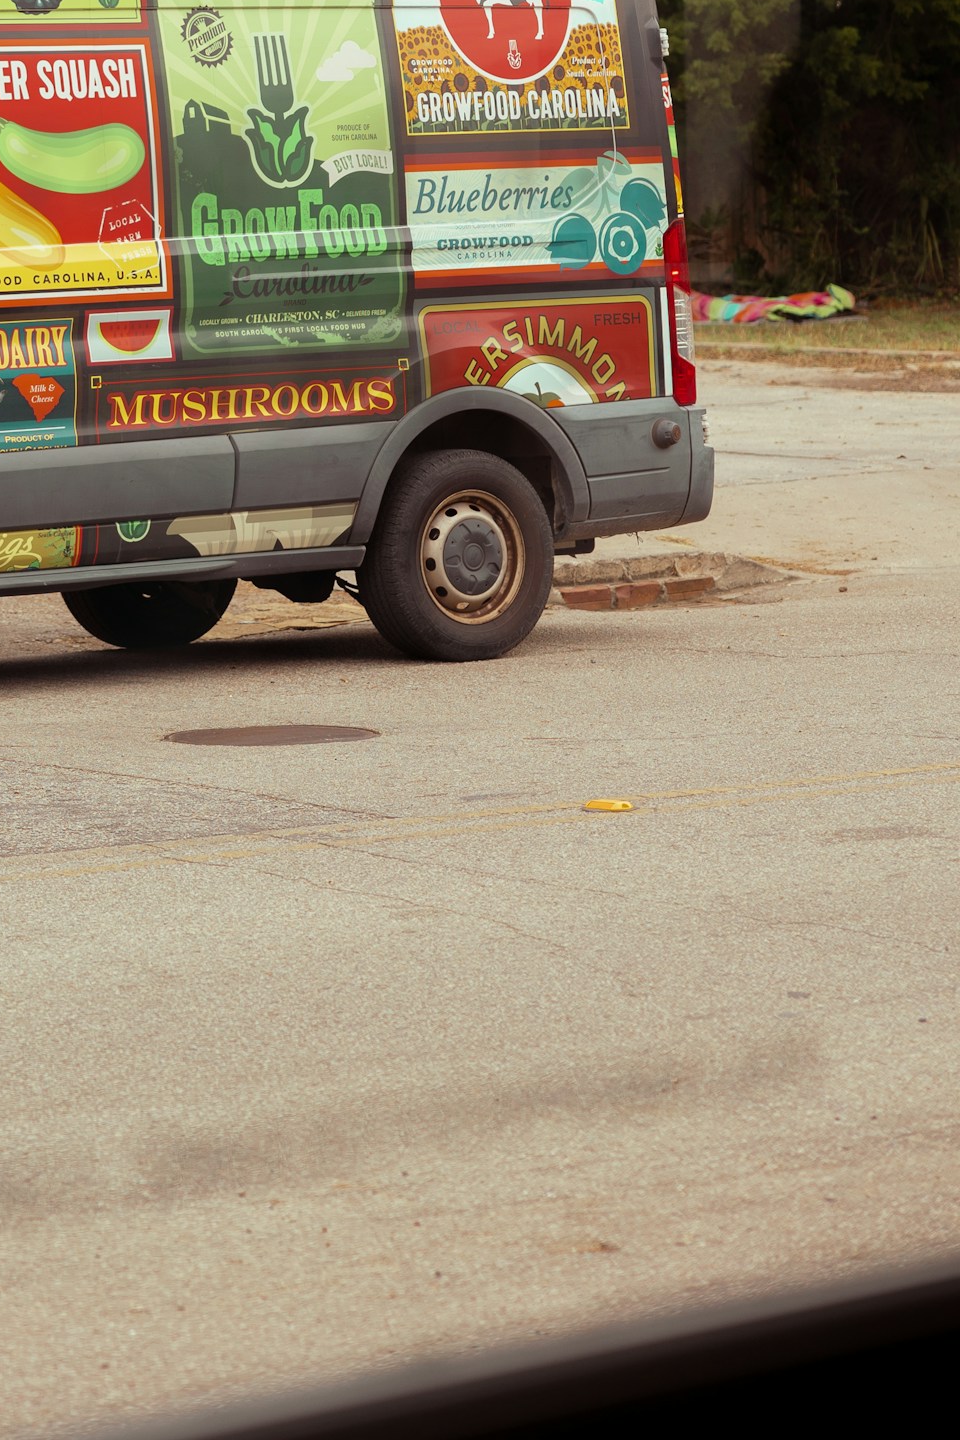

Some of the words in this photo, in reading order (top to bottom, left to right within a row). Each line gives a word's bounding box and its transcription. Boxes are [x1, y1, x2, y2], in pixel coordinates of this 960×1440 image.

[188, 21, 227, 52] Premium
[571, 56, 596, 65] Product
[36, 58, 137, 101] SQUASH
[566, 69, 585, 78] South
[416, 90, 521, 123] GROWFOOD
[527, 88, 620, 119] CAROLINA
[336, 123, 362, 131] PRODUCE
[363, 123, 370, 131] OF
[331, 134, 350, 142] SOUTH
[350, 133, 378, 141] CAROLINA
[333, 154, 355, 174] BUY
[356, 153, 388, 169] LOCAL!
[412, 173, 574, 215] Blueberries
[108, 213, 141, 231] LOCAL
[437, 235, 534, 251] GROWFOOD
[457, 251, 512, 260] CAROLINA
[33, 271, 111, 285] CAROLINA,
[116, 269, 158, 280] U.S.A.
[231, 262, 362, 299] Carolina
[199, 318, 220, 326] LOCALLY
[220, 317, 239, 325] GROWN
[245, 312, 323, 324] CHARLESTON,
[325, 310, 340, 320] SC
[345, 310, 371, 318] DELIVERED
[593, 312, 641, 326] FRESH
[215, 330, 239, 338] SOUTH
[432, 321, 483, 335] LOCAL
[30, 384, 46, 393] Milk
[48, 383, 56, 392] &
[31, 395, 54, 404] Cheese
[108, 379, 396, 429] MUSHROOMS
[4, 434, 42, 443] PRODUCT
